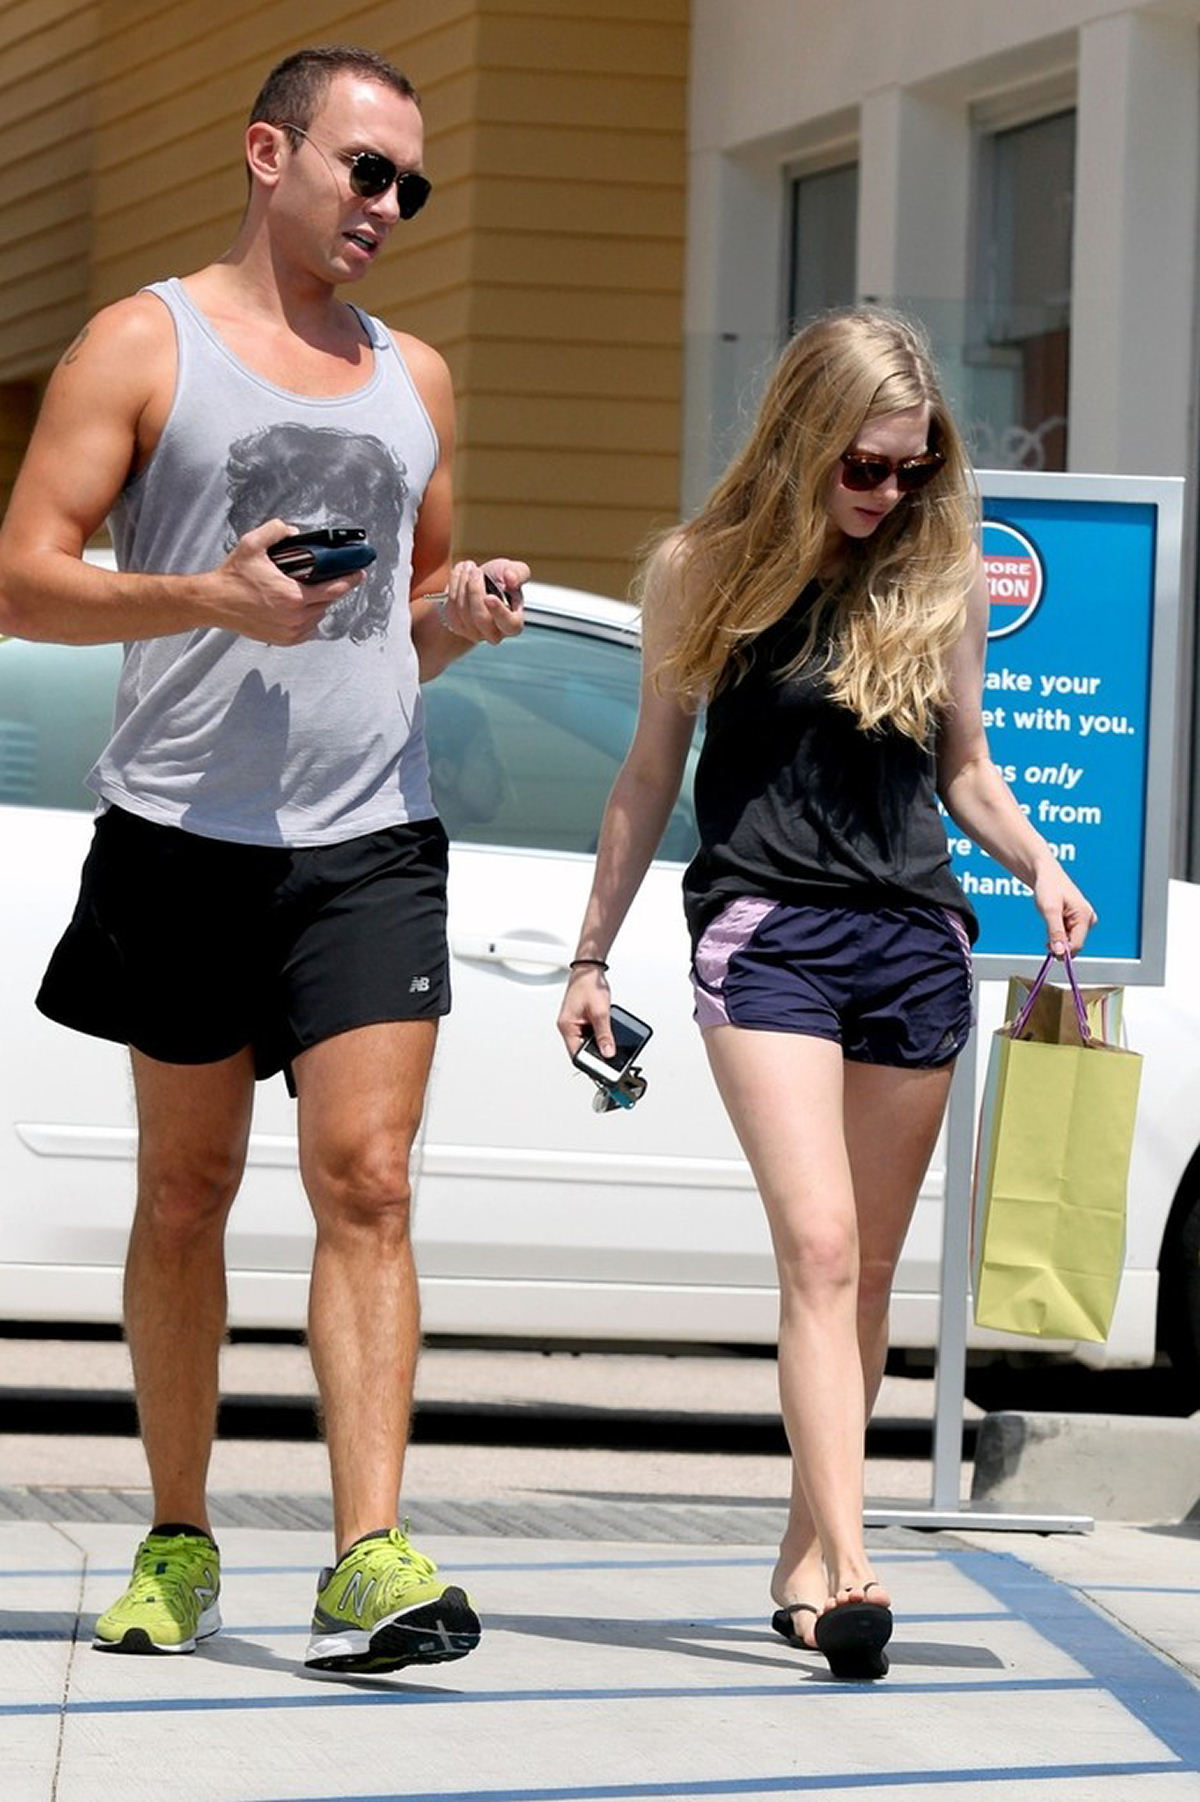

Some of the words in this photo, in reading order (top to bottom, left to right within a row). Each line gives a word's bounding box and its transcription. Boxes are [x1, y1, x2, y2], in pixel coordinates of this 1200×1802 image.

[986, 577, 1030, 598] ION
[984, 667, 1032, 691] ake
[1040, 674, 1101, 697] your
[1013, 707, 1071, 731] with
[1078, 714, 1135, 736] you.
[1024, 762, 1084, 789] only
[1038, 799, 1102, 824] from
[956, 871, 1035, 896] hants
[337, 1570, 377, 1617] N
